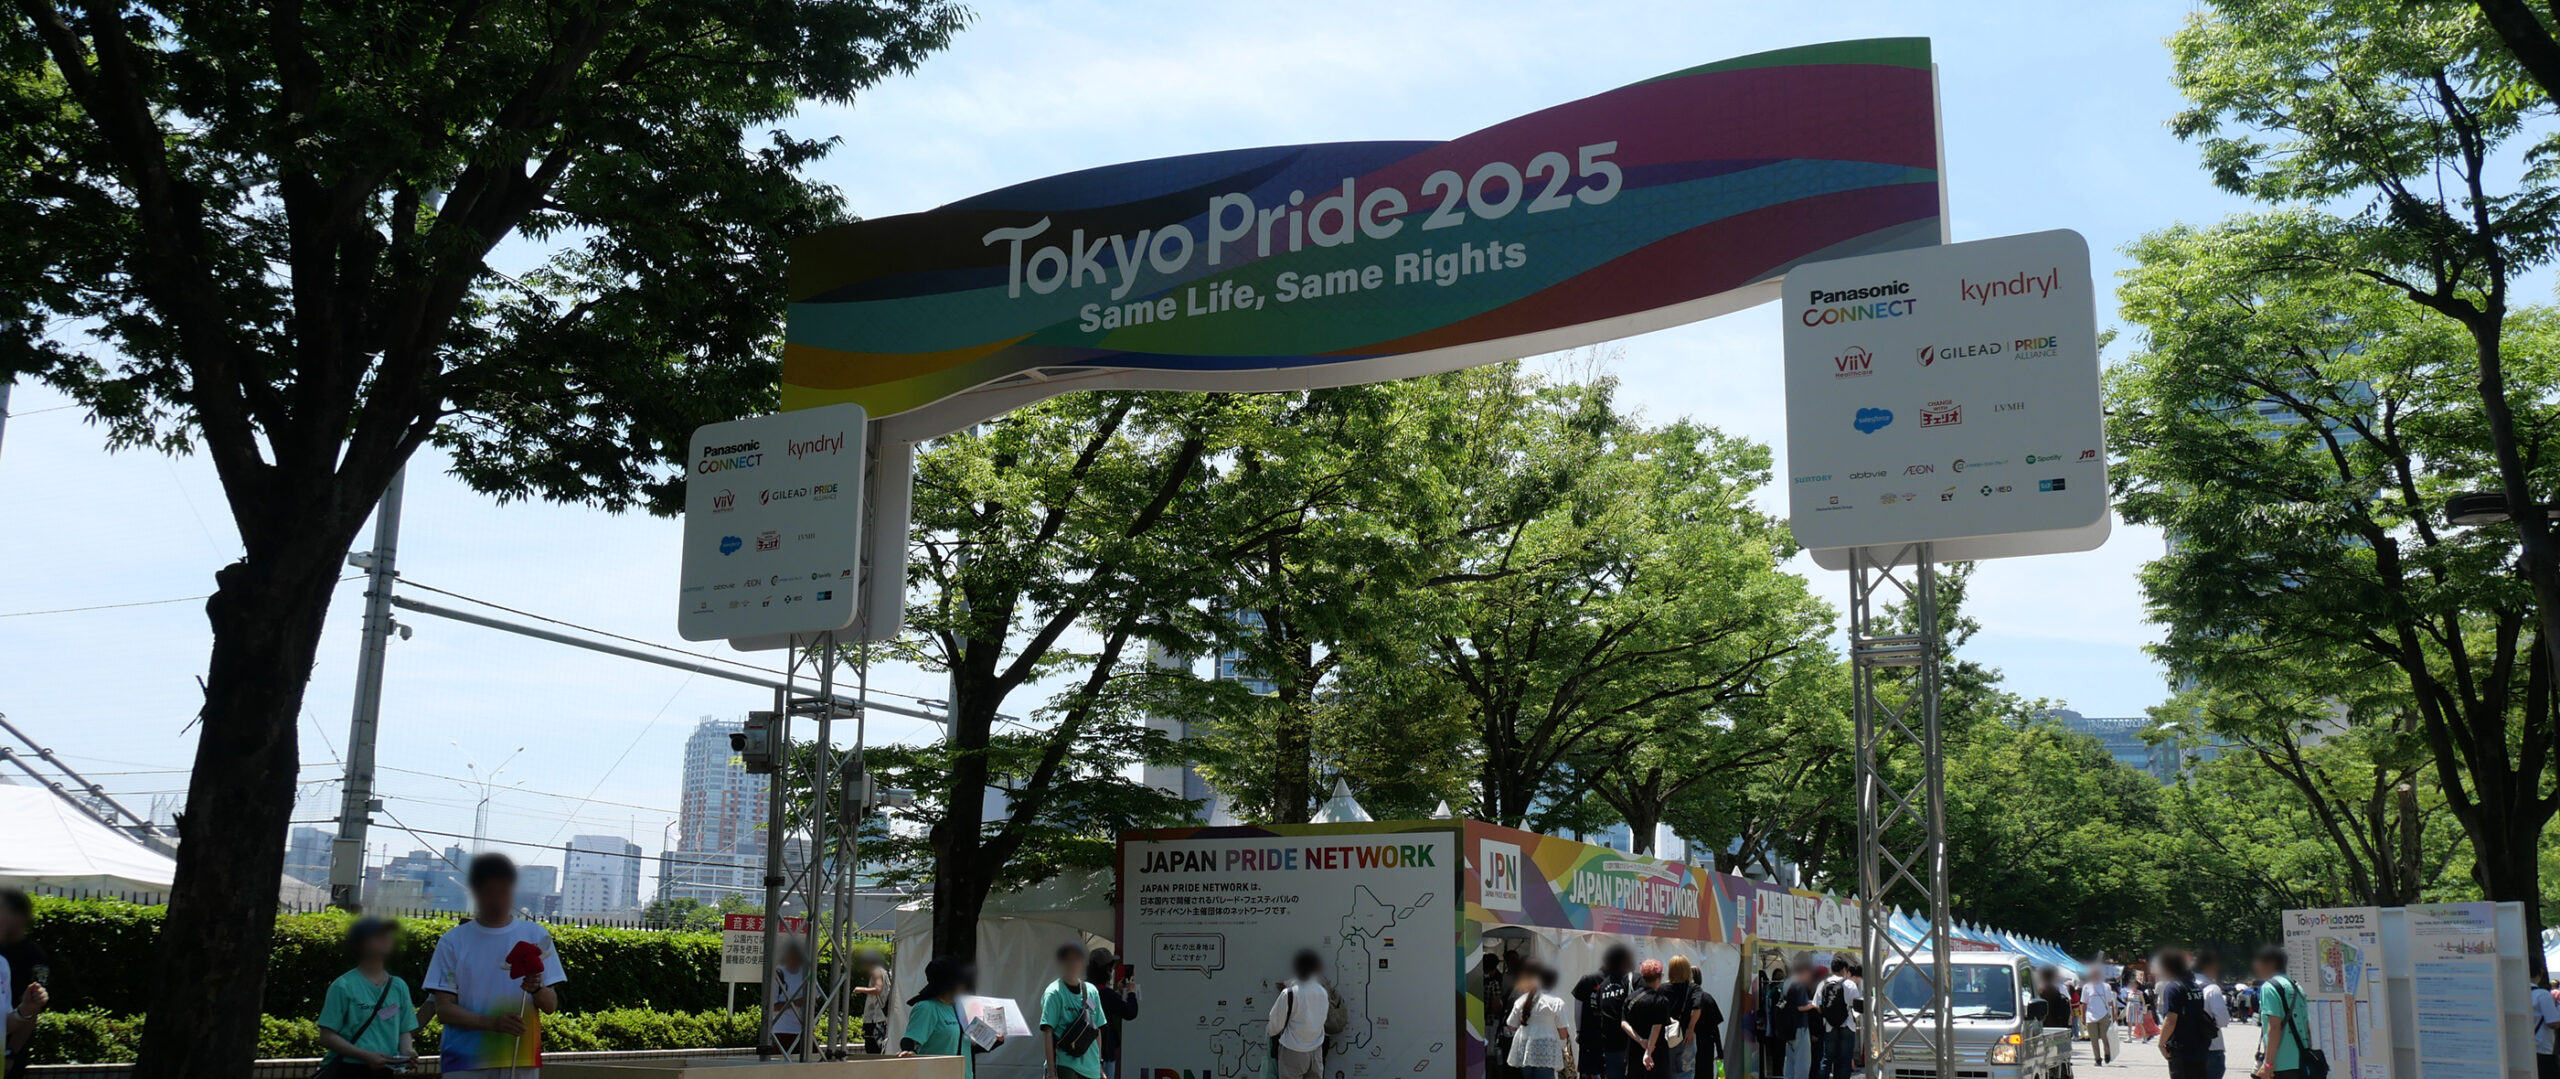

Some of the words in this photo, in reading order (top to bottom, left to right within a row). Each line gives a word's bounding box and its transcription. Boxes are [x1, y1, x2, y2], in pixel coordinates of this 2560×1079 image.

[982, 216, 1194, 301] Tokyo
[1208, 177, 1408, 266] Pride
[1421, 141, 1623, 230] 2025
[1079, 297, 1176, 332] Same
[1187, 280, 1265, 317] Life,
[1276, 263, 1384, 303] Same
[1395, 241, 1527, 286] Rights
[1810, 280, 1910, 305] Panasonic
[1961, 267, 2059, 305] kyndryl
[1803, 299, 1917, 327] CONNECT
[1940, 343, 2001, 360] GILEAD
[2015, 336, 2057, 351] PRIDE
[1835, 352, 1873, 371] ViiV
[2014, 350, 2058, 360] ALLIANCE
[1994, 402, 2024, 412] LVMH
[1923, 411, 1959, 425] チェリオ
[704, 439, 760, 458] Panasonic
[788, 432, 844, 460] kyndryl
[2037, 454, 2062, 463] Spotify
[2079, 450, 2096, 460] JTB
[698, 454, 763, 474] CONNECT
[1850, 470, 1887, 480] abbvie
[772, 488, 807, 501] GILEAD
[814, 484, 838, 495] PRIDE
[1941, 493, 1954, 502] EY
[713, 494, 735, 509] ViiV
[1140, 850, 1217, 874] JAPAN
[1225, 848, 1298, 872] PRIDE
[1305, 844, 1436, 871] NETWORK
[1485, 851, 1517, 891] JPN
[1140, 883, 1170, 893] JAPAN
[1172, 883, 1200, 893] PRIDE
[1202, 882, 1249, 892] NETWORK
[1569, 869, 1612, 907] JAPAN
[1615, 876, 1650, 912] PRIDE
[1652, 883, 1700, 919] NETWORK
[2294, 913, 2320, 927] Tokyo
[2320, 913, 2343, 925] Pride
[2344, 914, 2365, 924] 2025
